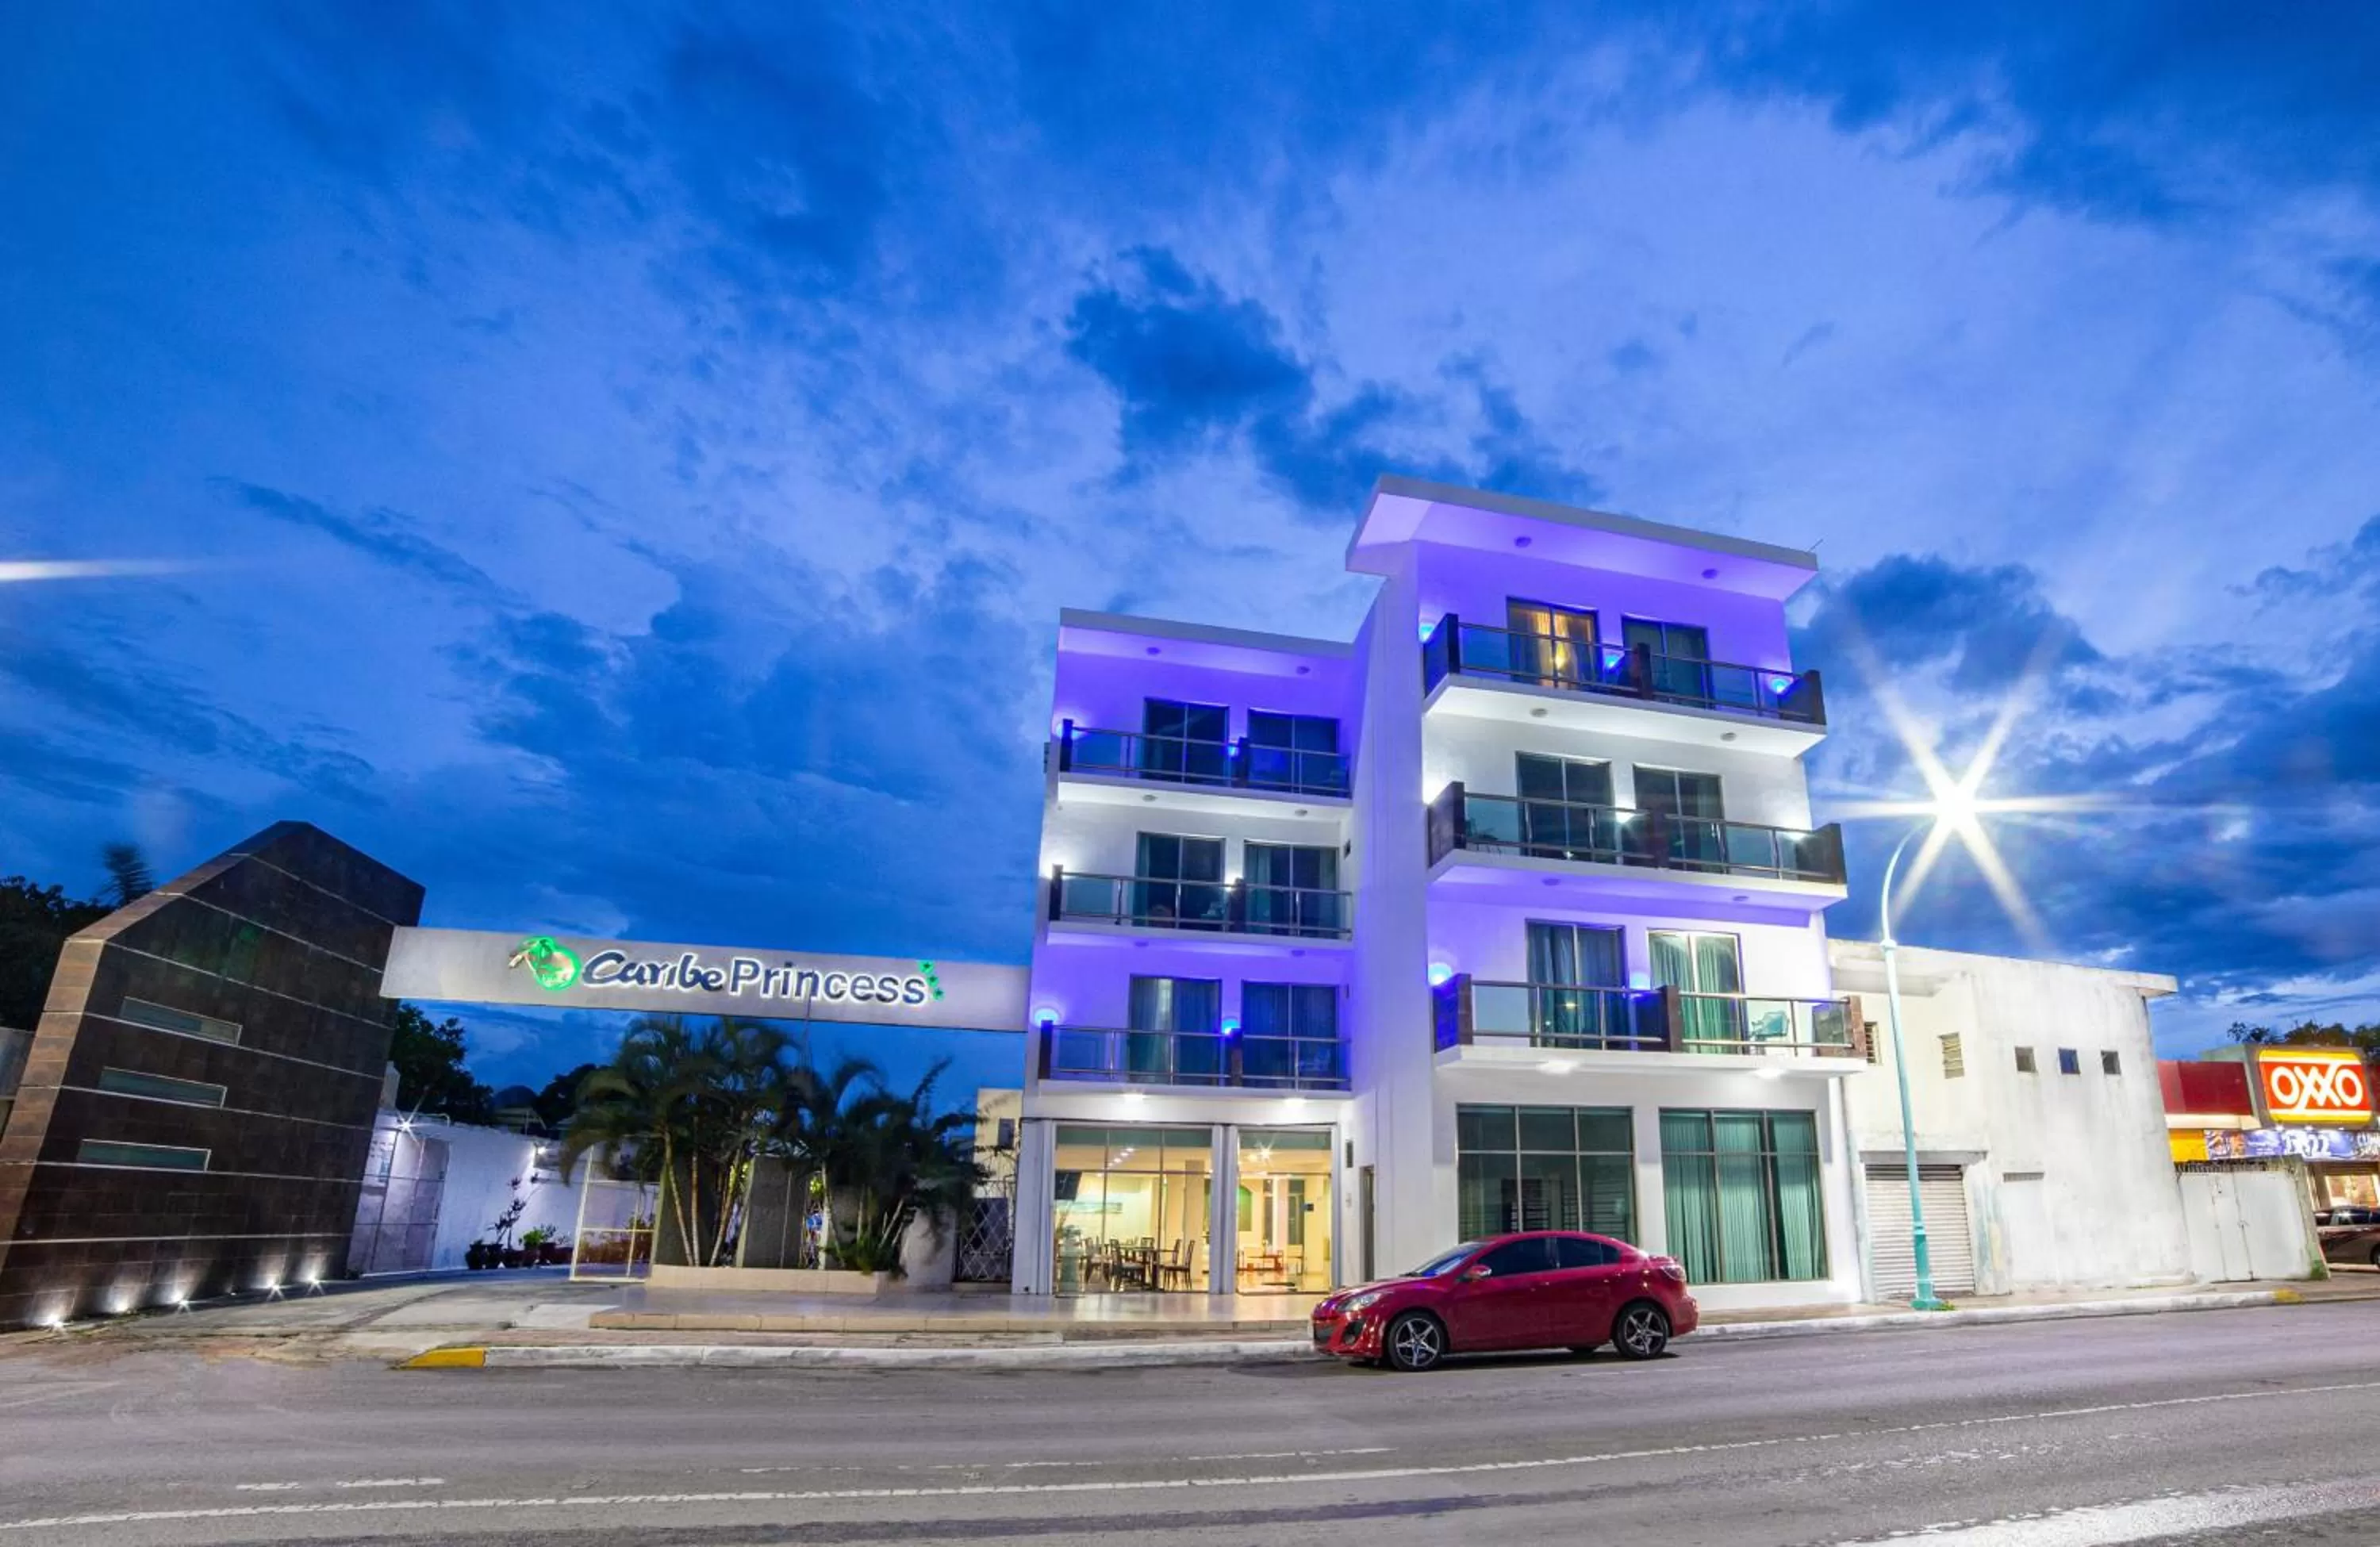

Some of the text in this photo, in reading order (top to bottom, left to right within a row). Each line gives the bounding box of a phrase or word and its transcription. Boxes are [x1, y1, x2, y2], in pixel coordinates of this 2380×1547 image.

[582, 950, 927, 1005] Caribe Princess
[2271, 1063, 2363, 1111] OXXO
